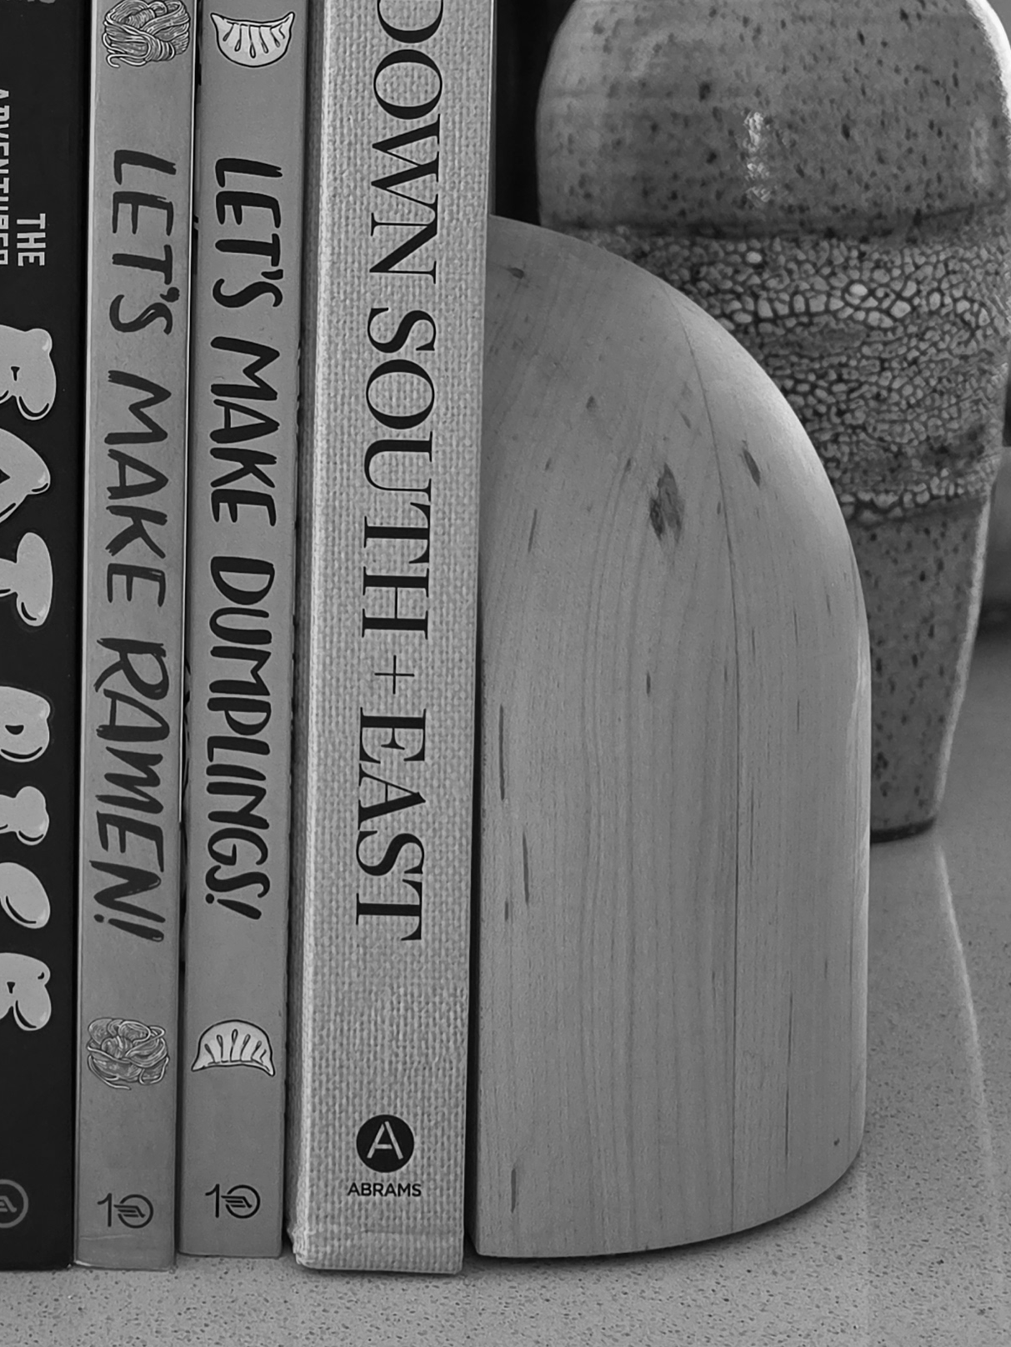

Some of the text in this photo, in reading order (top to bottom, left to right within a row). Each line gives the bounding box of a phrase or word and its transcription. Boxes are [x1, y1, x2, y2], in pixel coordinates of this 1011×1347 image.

[17, 213, 46, 267] THE
[89, 149, 180, 942] LET'S MAKE RAMEN!
[205, 157, 284, 920] LET'S MAKE DUMPLINGS!
[361, 307, 436, 640] SOUTH
[356, 707, 427, 942] EAST
[347, 1182, 422, 1197] ABRAMS
